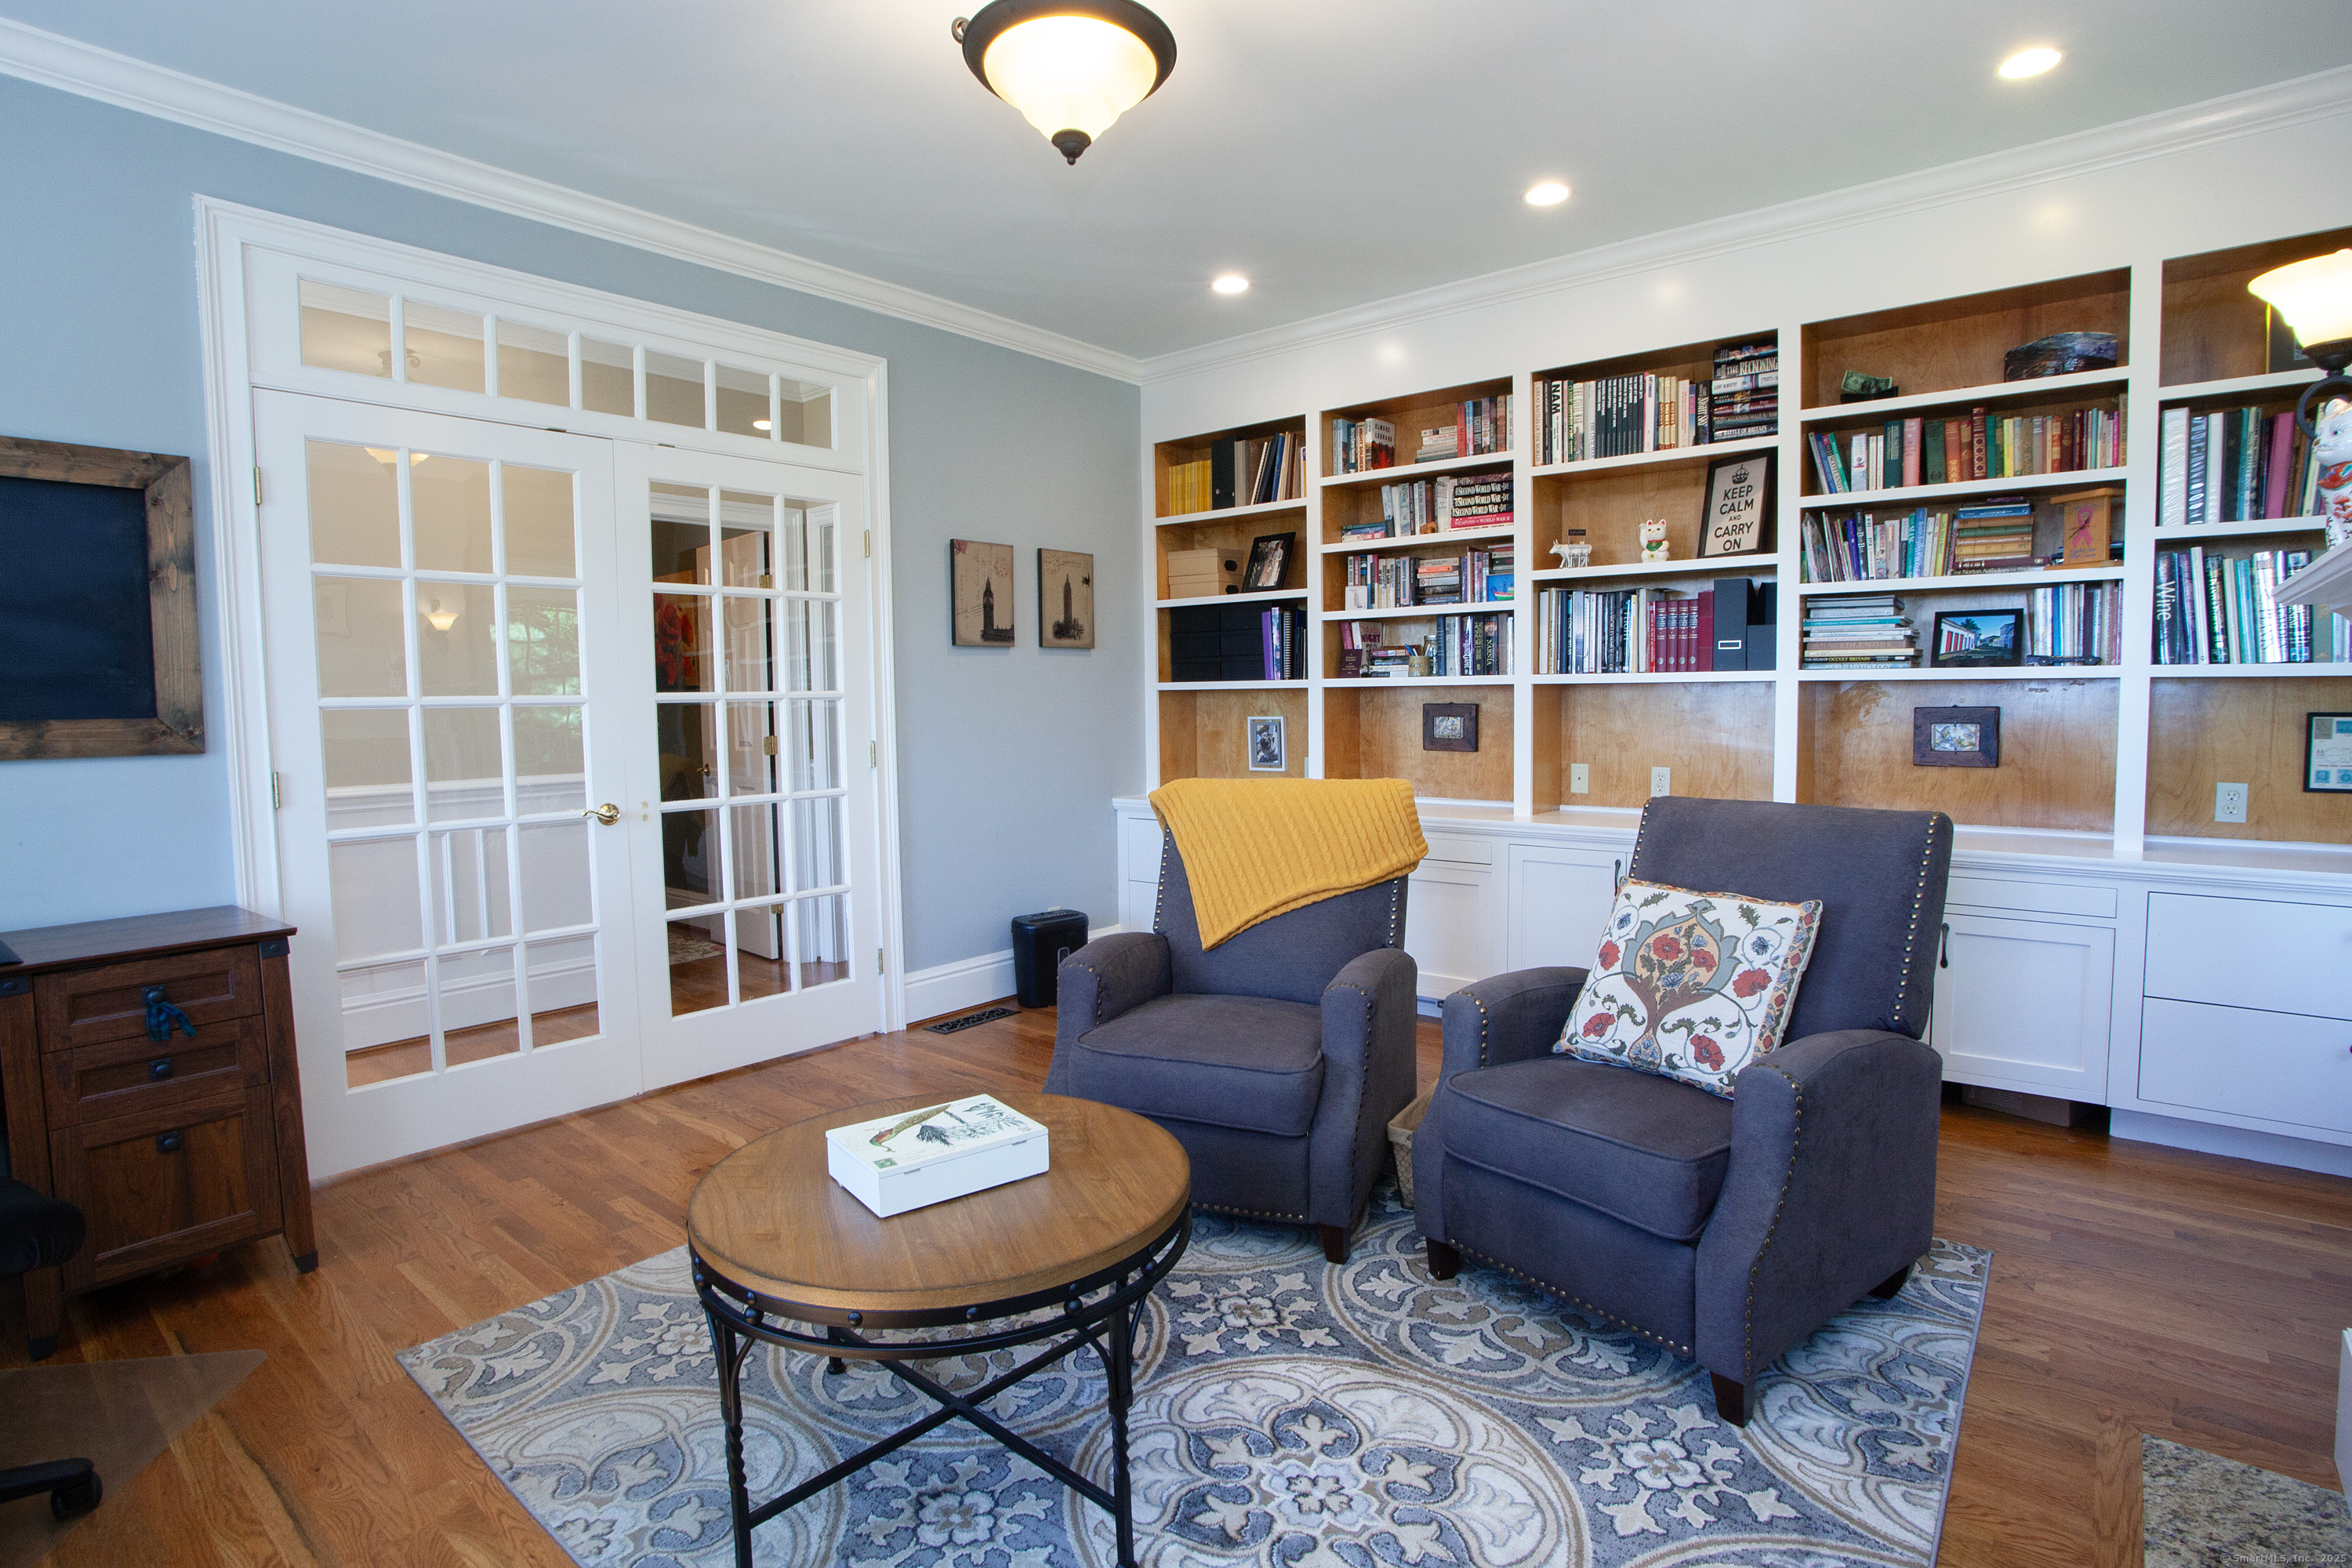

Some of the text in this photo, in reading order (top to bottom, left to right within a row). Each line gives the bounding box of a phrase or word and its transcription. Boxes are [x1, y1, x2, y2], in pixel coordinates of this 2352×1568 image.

[1726, 357, 1778, 376] THE RECKONING
[1552, 384, 1561, 416] NAM
[1697, 397, 1709, 426] NIGHT SKY
[1374, 423, 1391, 434] ELMORE
[1473, 416, 1482, 445] FIGHTER BOYS
[1748, 425, 1768, 434] BRITAIN
[1374, 433, 1393, 443] LEONARD
[1829, 456, 1842, 491] SCOTLAND
[1458, 485, 1475, 496] SECOND
[1475, 484, 1491, 494] WORLD
[1490, 482, 1501, 492] WAR
[1723, 485, 1753, 502] KEEP
[1457, 496, 1475, 507] SECOND
[1475, 495, 1491, 505] WORLD
[1490, 493, 1501, 503] WAR
[1719, 498, 1755, 515] CALM
[1454, 507, 1472, 517] SECOND
[1472, 505, 1489, 515] WORLD
[1488, 504, 1499, 514] WAR
[1714, 521, 1755, 539] CARRY
[1722, 538, 1742, 552] ON
[2155, 580, 2176, 621] Wine
[1360, 633, 1381, 644] NIGHT
